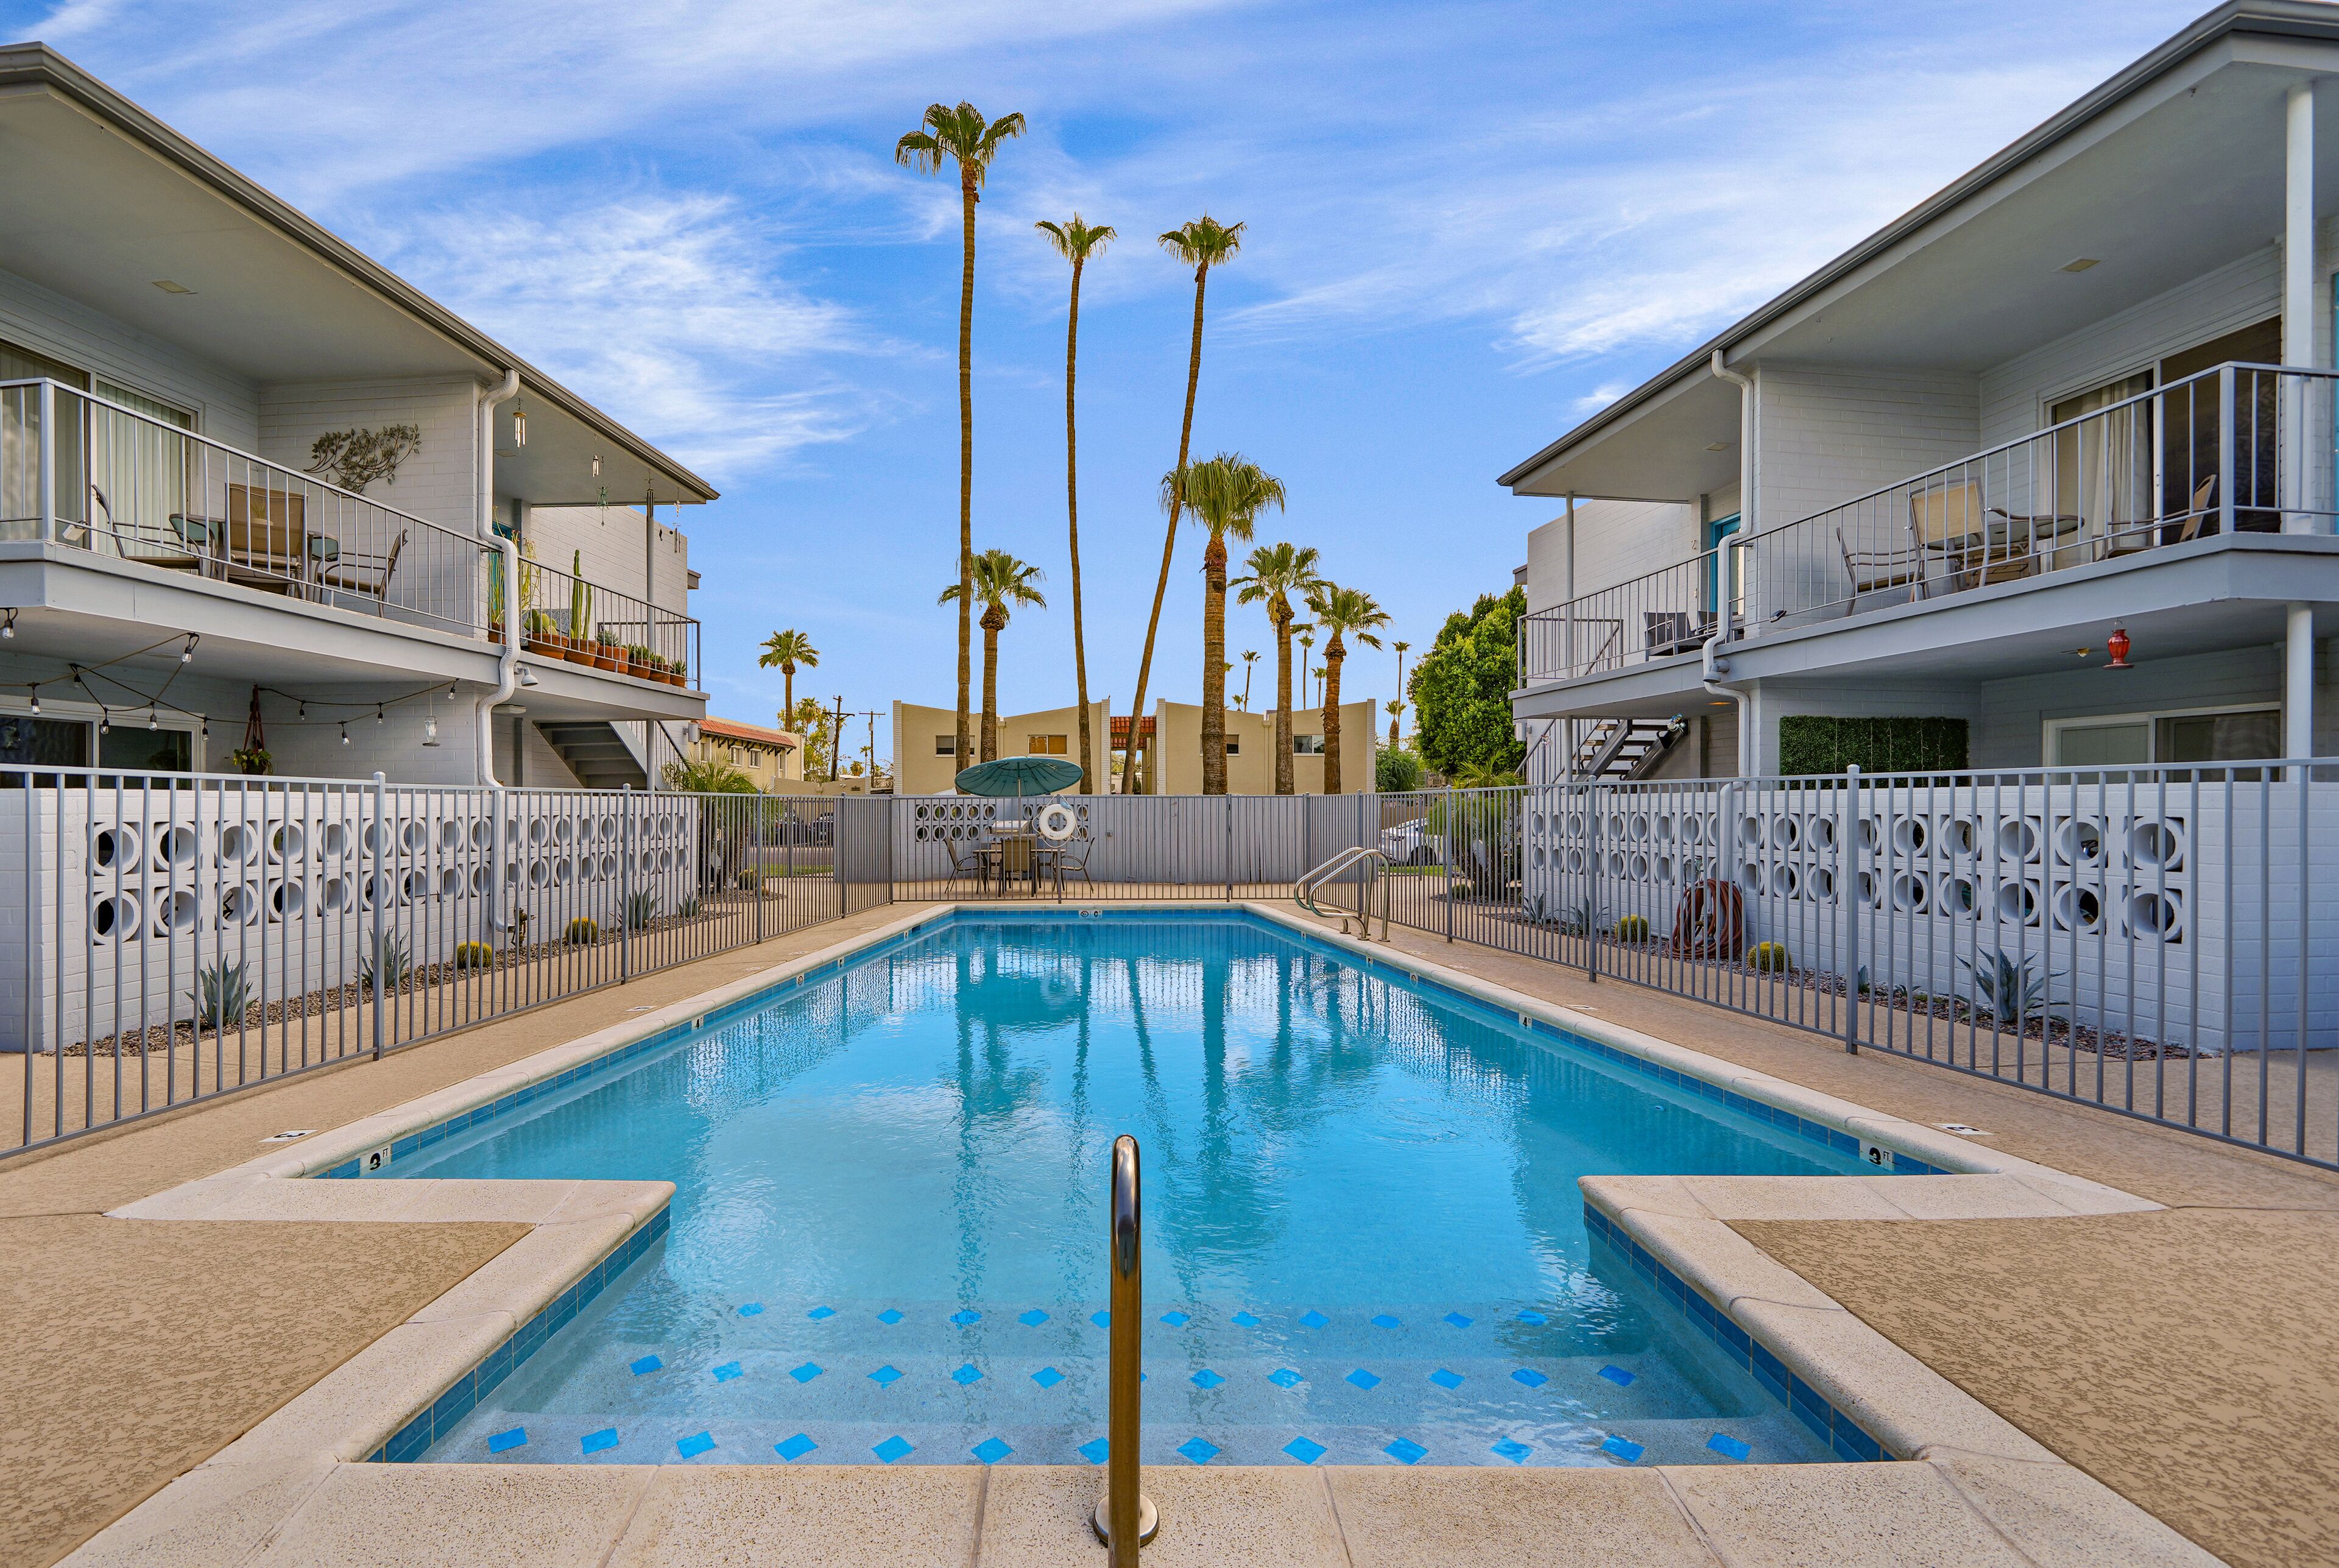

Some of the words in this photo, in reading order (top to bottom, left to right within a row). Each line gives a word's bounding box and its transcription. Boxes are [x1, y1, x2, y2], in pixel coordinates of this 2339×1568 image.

[370, 1153, 381, 1171] 3
[383, 1148, 389, 1158] FT
[1869, 1147, 1882, 1165] 3
